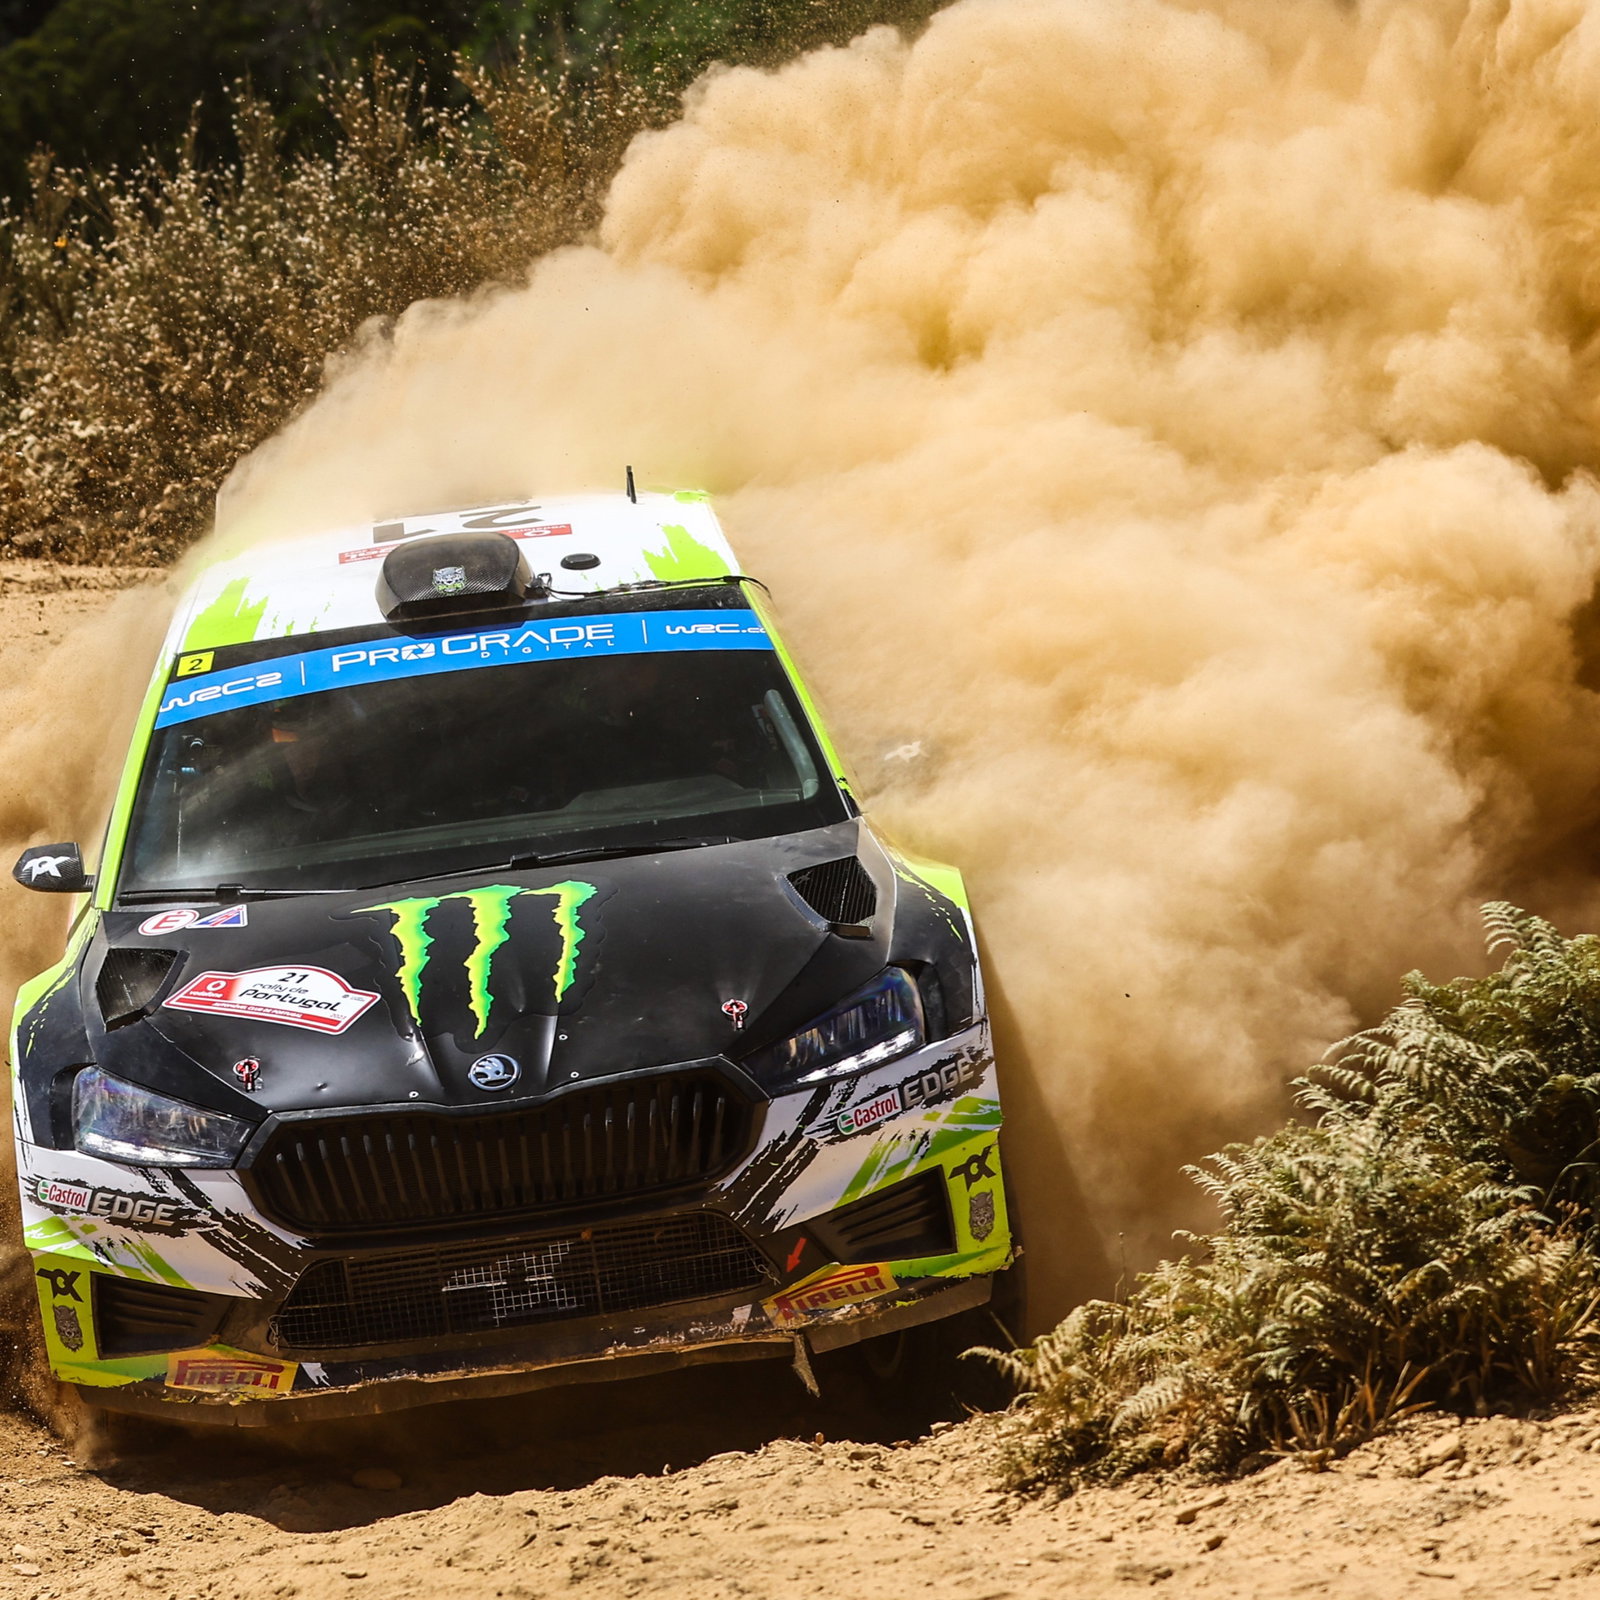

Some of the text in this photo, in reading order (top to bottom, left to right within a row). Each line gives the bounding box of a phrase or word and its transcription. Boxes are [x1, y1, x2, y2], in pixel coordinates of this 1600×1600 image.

[188, 658, 203, 671] 2
[480, 640, 615, 659] DIGITAL
[158, 671, 282, 713] WRC2
[252, 983, 309, 994] rally de
[278, 972, 309, 984] 21
[854, 1059, 975, 1127] Castrol EDGE
[49, 1184, 180, 1227] Castrol EDGE
[773, 1265, 887, 1321] PIRELLI
[174, 1358, 285, 1390] PIRELLI
